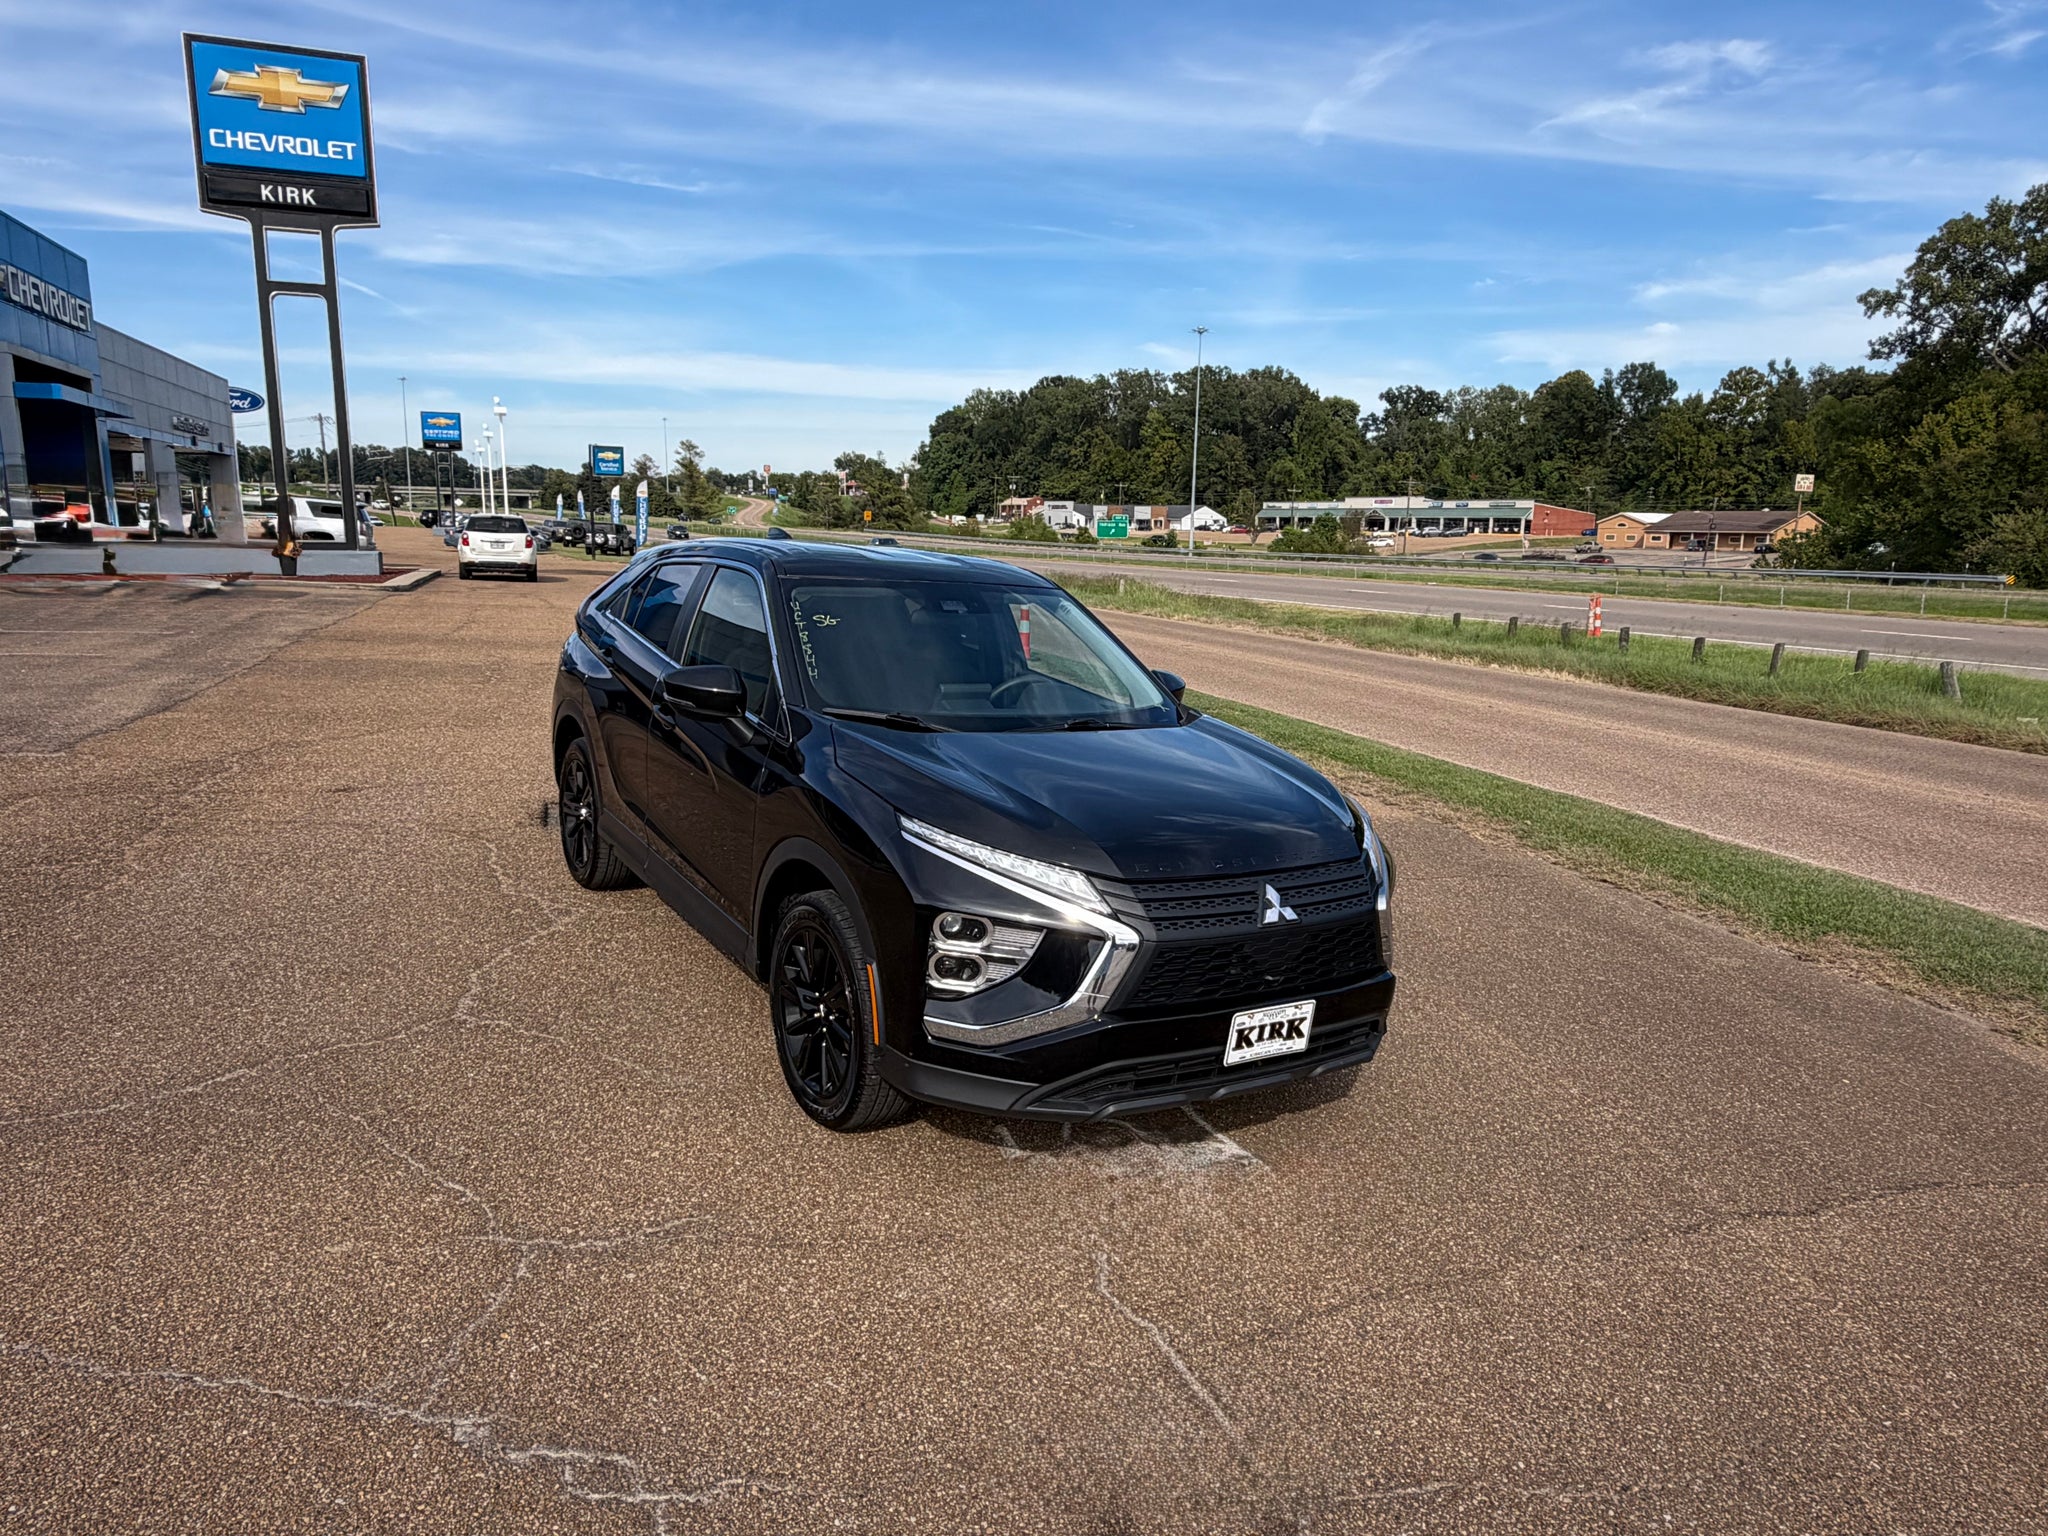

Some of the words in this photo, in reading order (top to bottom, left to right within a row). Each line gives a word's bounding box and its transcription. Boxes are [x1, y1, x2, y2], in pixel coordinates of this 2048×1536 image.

[209, 128, 357, 161] CHEVROLET
[260, 184, 317, 206] KIRK
[7, 264, 92, 332] CHEVROLET
[1232, 1016, 1308, 1052] KIRK
